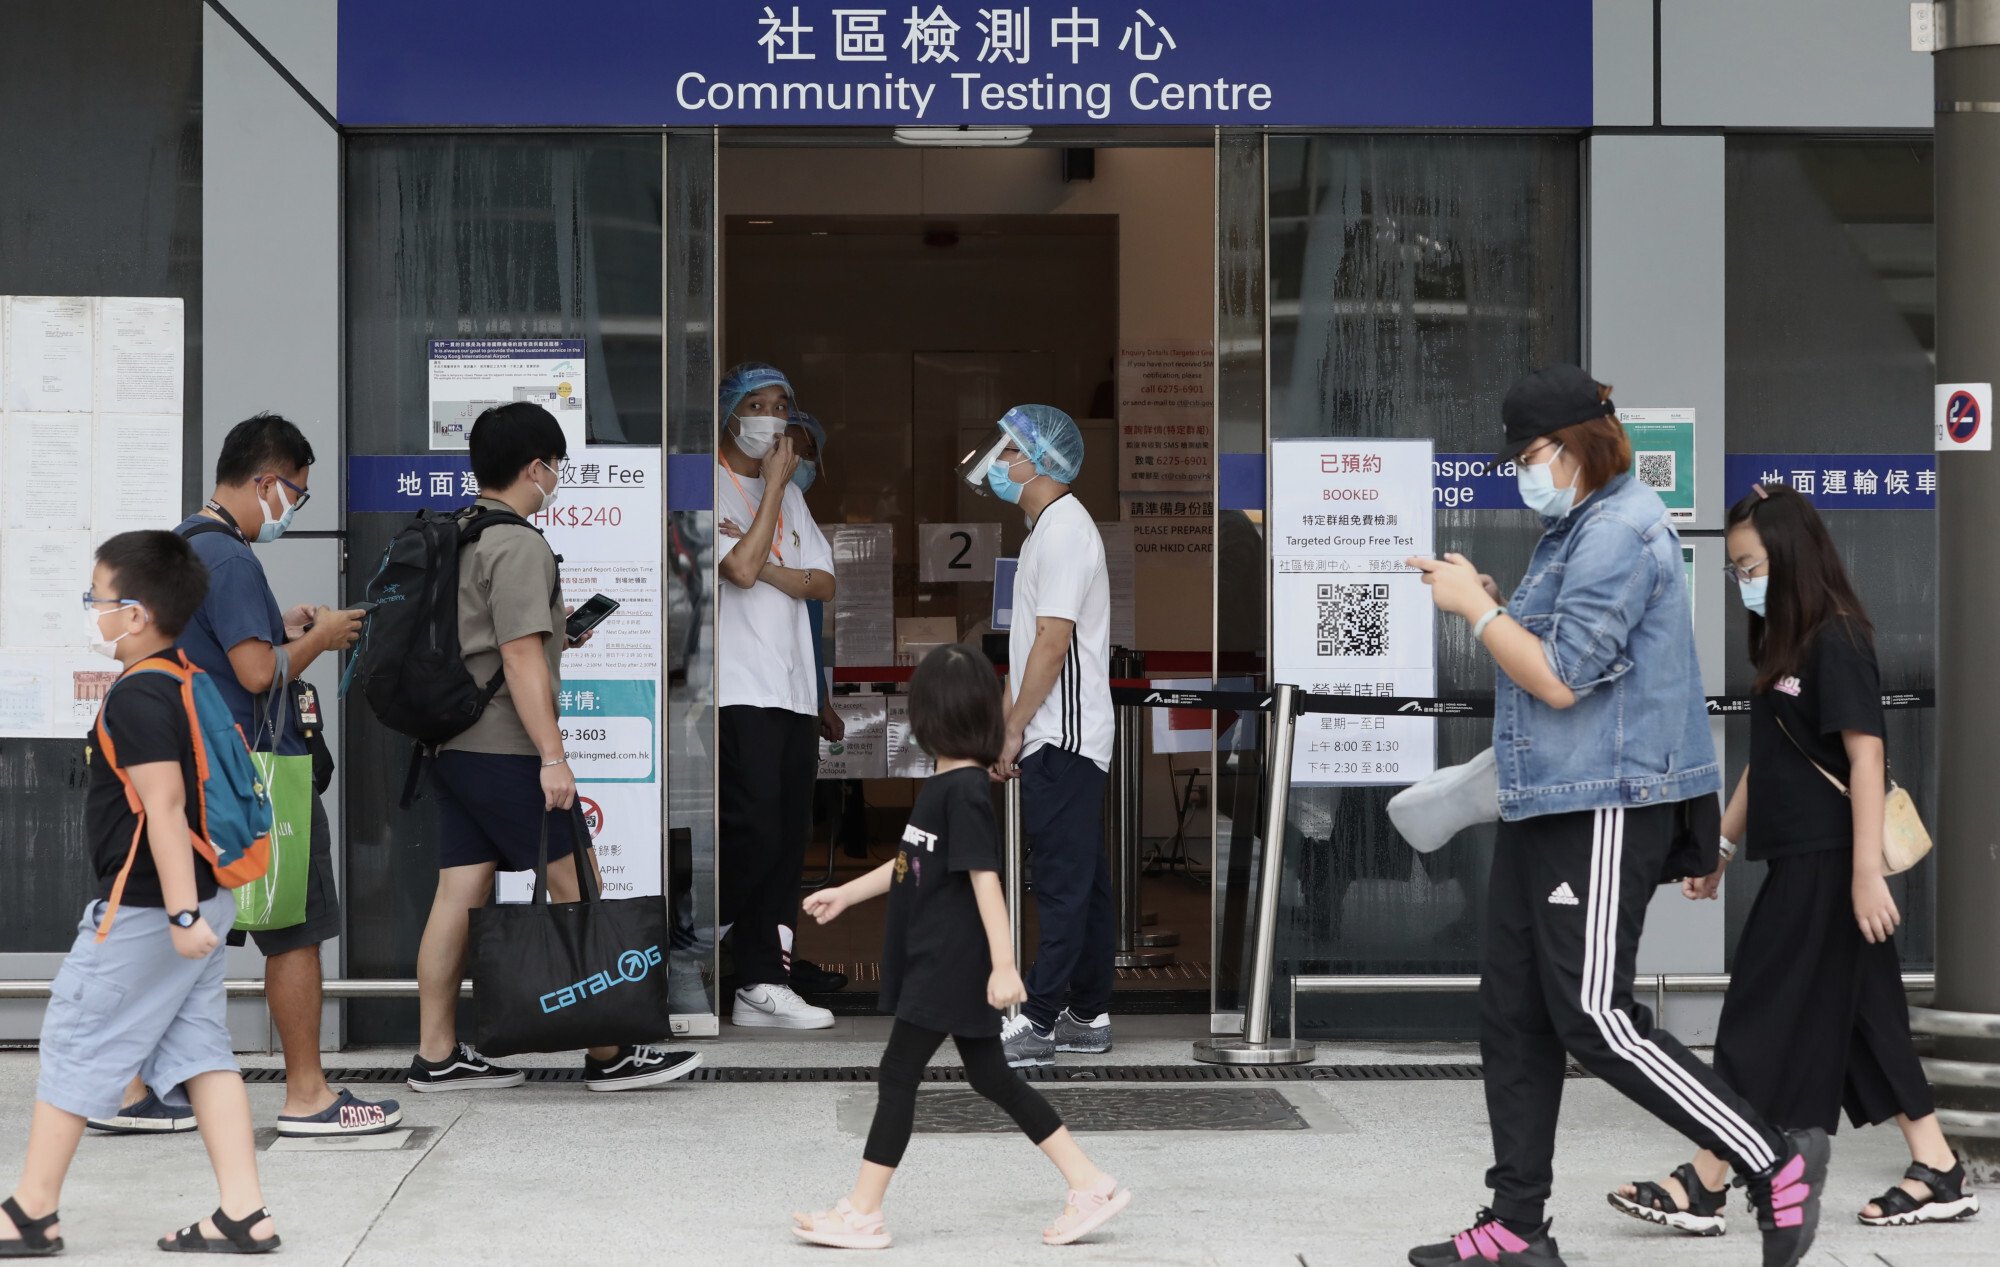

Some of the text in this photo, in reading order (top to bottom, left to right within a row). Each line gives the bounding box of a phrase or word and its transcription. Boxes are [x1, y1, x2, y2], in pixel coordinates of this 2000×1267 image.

[757, 5, 1177, 65] 社區檢測中心
[676, 73, 1272, 119] Community Testing Centre
[1121, 349, 1146, 357] Enquiry
[1141, 385, 1204, 393] call 6275-6901
[1135, 456, 1207, 466] 致電 6275-6901
[1320, 454, 1382, 473] 已預約
[608, 465, 645, 484] Fee
[1323, 489, 1379, 501] BOOKED
[534, 505, 622, 528] HK$240
[1303, 514, 1398, 526] 特定群組免費檢測
[1134, 525, 1213, 535] PLEASE PREPARE
[1160, 543, 1185, 553] HKID
[1286, 536, 1414, 548] Targeted Group Free Test
[948, 531, 973, 569] 2
[593, 566, 612, 574] Report
[1279, 559, 1351, 571] 社區檢測中心
[1320, 717, 1385, 730] 星期一至日
[561, 729, 606, 741] 9-3603
[1307, 741, 1399, 752] 上午 8:00 至 1:30
[819, 767, 847, 775] Octopus
[1307, 763, 1399, 774] 下午 2:30 至 8:00
[340, 1104, 386, 1128] CROCS
